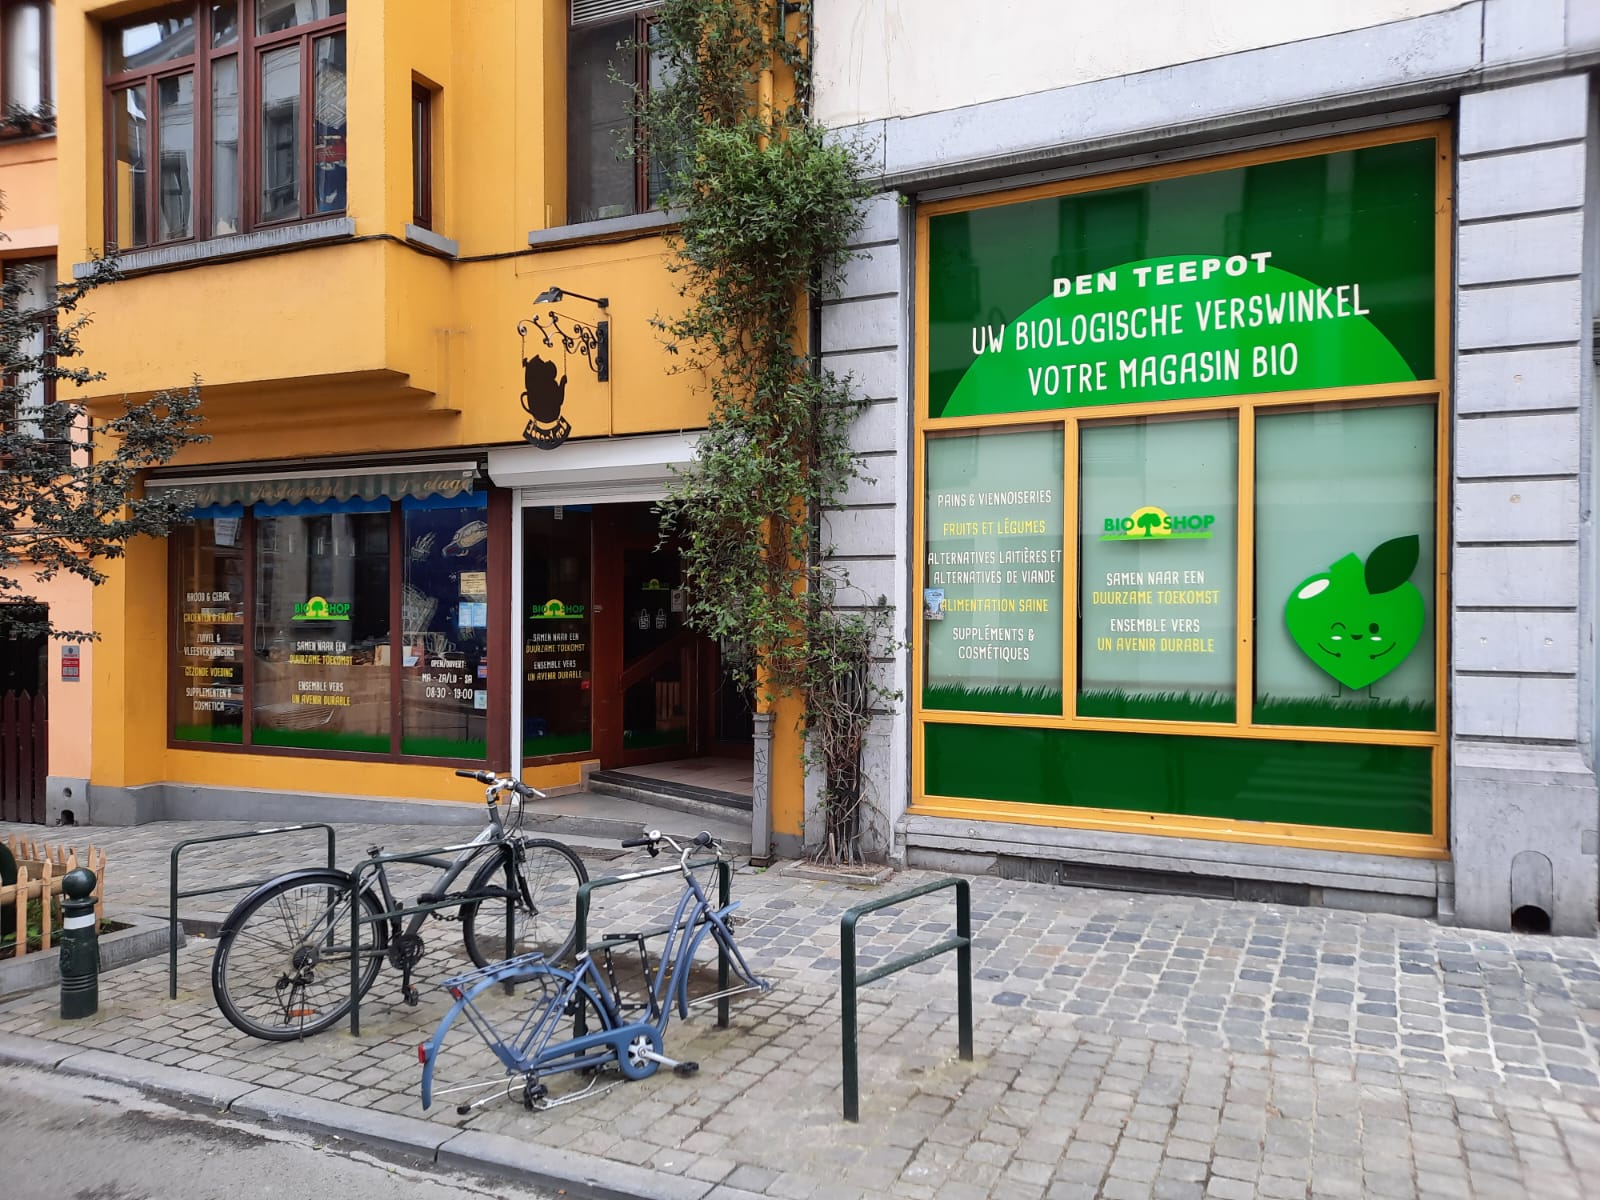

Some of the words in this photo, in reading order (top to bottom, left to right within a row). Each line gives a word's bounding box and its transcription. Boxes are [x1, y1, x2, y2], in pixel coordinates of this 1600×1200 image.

[1053, 271, 1117, 298] DEN
[1132, 251, 1273, 288] TEEPOT
[972, 324, 1005, 355] UW
[1015, 304, 1183, 351] BIOLOGISCHE
[1195, 284, 1370, 332] VERSWINKEL
[1028, 361, 1108, 396] VOTRE
[1119, 348, 1240, 390] MAGASIN
[1252, 342, 1298, 378] BIO
[937, 493, 967, 508] PAINS
[969, 493, 976, 506] &
[979, 489, 1052, 506] VIENNOISERIES
[943, 522, 979, 536] FRUITS
[981, 521, 994, 535] ET
[997, 517, 1047, 535] LÉGUMES
[1104, 517, 1135, 532] BIO
[1163, 514, 1215, 530] SHOP
[927, 551, 996, 565] ALTERNATIVES
[999, 546, 1047, 564] LAITIÈRES
[1050, 549, 1062, 563] ET
[933, 570, 1002, 584] ALTERNATIVES
[1006, 570, 1018, 583] DE
[1021, 569, 1056, 583] VIANDE
[1106, 572, 1144, 586] SAMEN
[1147, 571, 1179, 585] NAAR
[1183, 570, 1205, 584] EEN
[940, 598, 1015, 613] ALIMENTATION
[1018, 598, 1049, 612] SAINE
[1092, 590, 1153, 605] DUURZAME
[1157, 590, 1219, 605] TOEKOMST
[952, 623, 1024, 641] SUPPLÉMENTS
[1027, 627, 1035, 641] &
[1110, 618, 1167, 632] ENSEMBLE
[1171, 618, 1201, 633] VERS
[958, 643, 1030, 662] COSMÉTIQUES
[1097, 637, 1112, 651] UN
[1116, 637, 1156, 652] AVENIR
[1160, 638, 1215, 653] DURABLE
